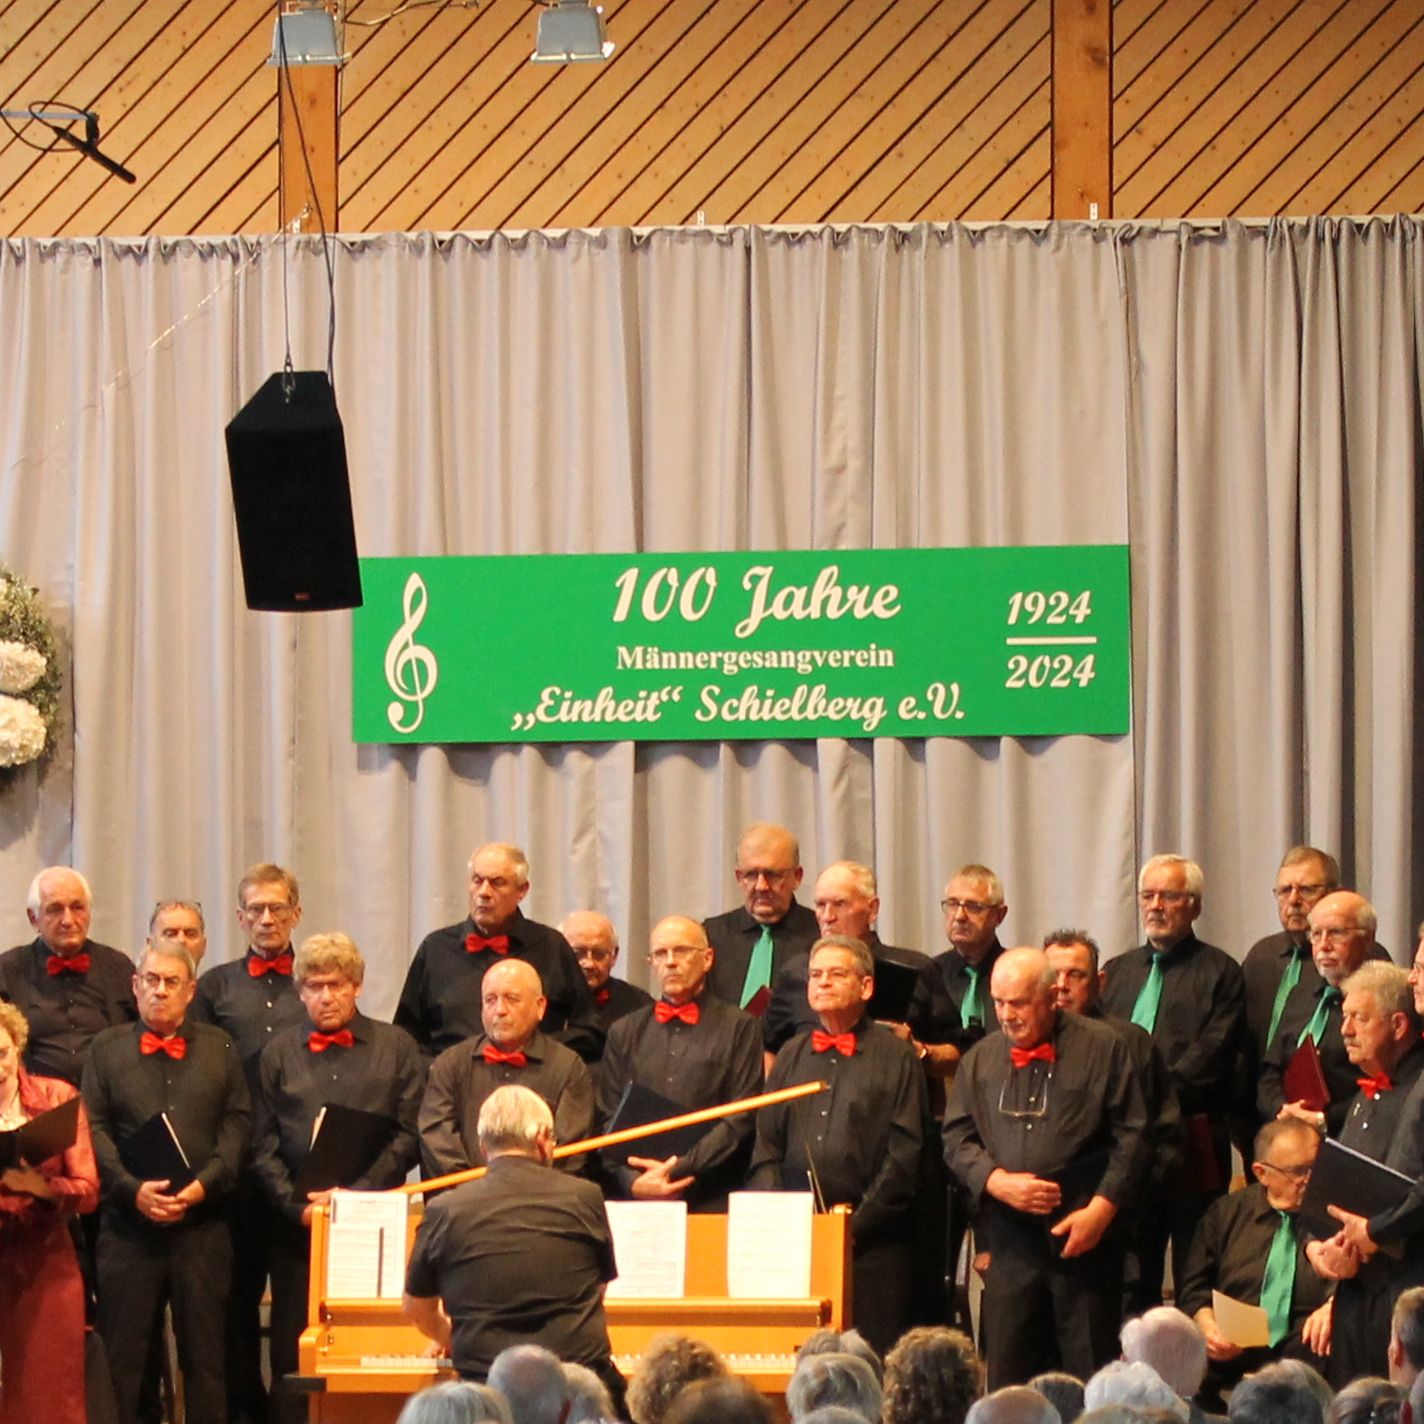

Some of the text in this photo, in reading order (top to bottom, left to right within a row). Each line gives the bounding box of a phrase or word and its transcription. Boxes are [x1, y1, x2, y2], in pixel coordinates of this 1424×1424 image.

[612, 564, 902, 639] 100 Jahre
[1006, 590, 1093, 625] 1924
[616, 642, 895, 676] Männergesangverein
[1004, 653, 1096, 689] 2024
[510, 682, 965, 732] „Einheit“ Schielberg e.V.
